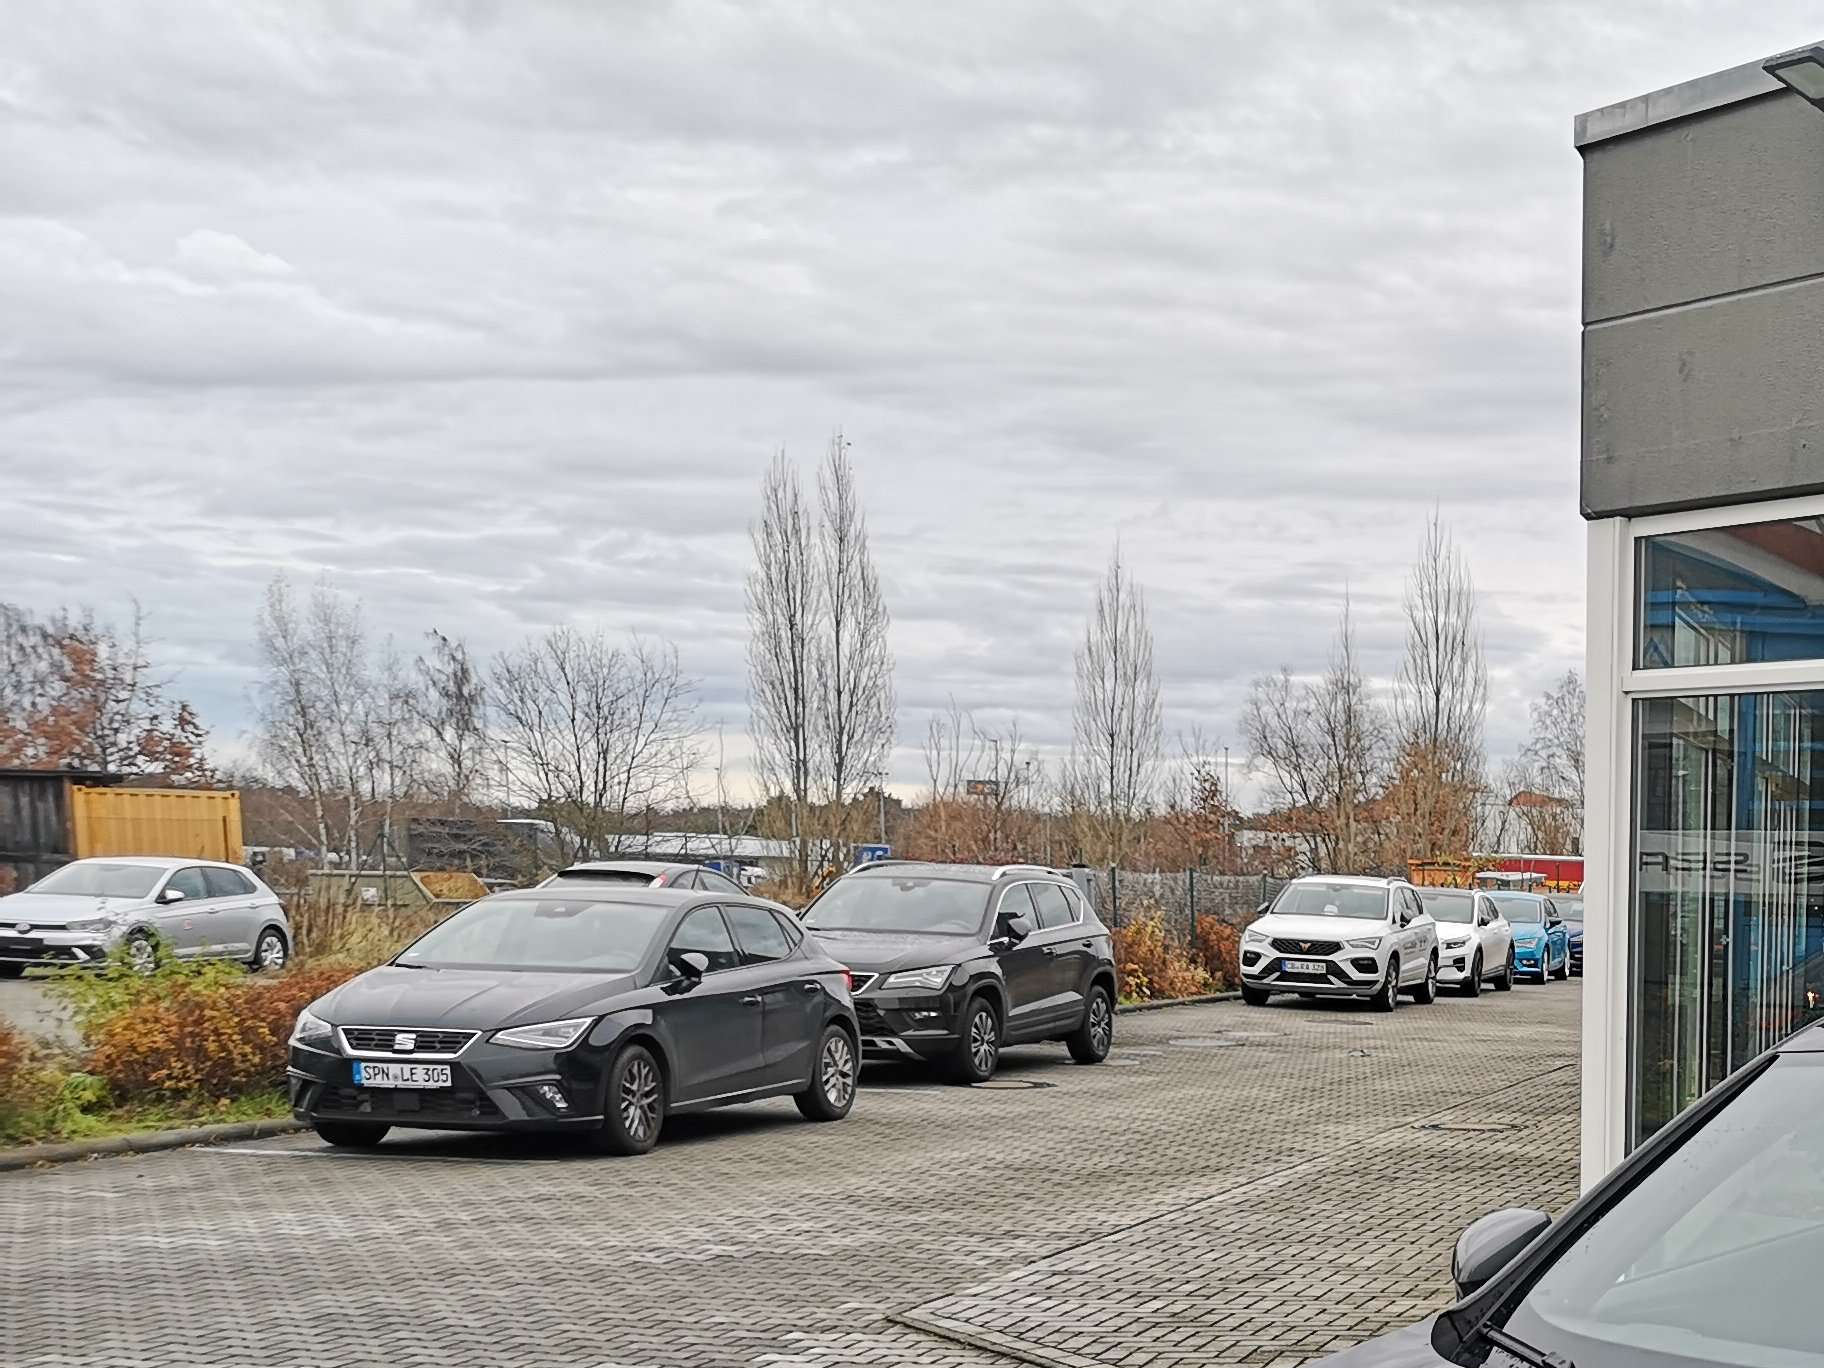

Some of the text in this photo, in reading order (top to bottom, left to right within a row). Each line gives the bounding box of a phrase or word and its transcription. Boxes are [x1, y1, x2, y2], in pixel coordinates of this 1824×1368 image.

[364, 1065, 449, 1083] SPN LE 305
